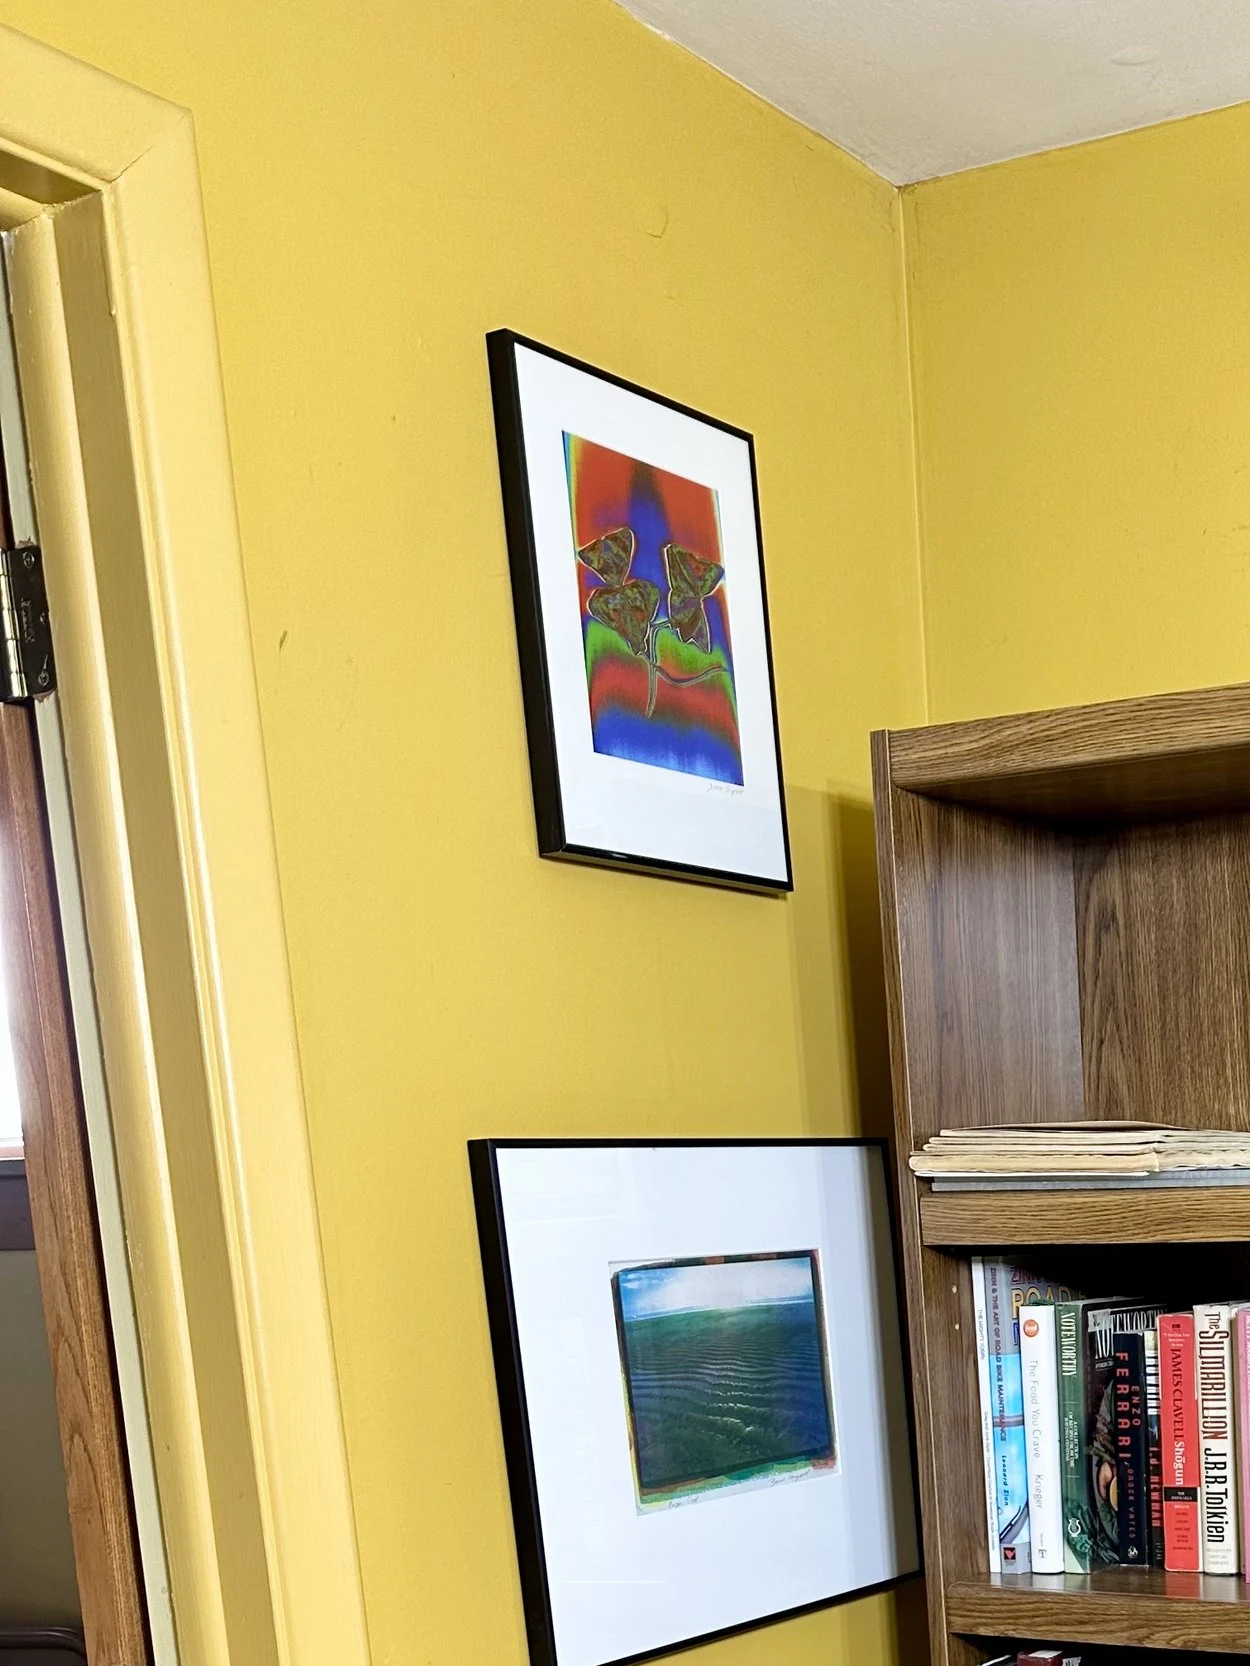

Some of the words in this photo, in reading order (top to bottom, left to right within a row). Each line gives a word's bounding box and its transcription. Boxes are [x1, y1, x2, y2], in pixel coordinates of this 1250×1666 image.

[1205, 1312, 1221, 1330] The
[1060, 1312, 1077, 1377] NOTEWORTHY
[1029, 1360, 1038, 1378] The
[1171, 1350, 1182, 1387] JAMES
[1198, 1330, 1228, 1440] SILMARILLION
[1030, 1381, 1040, 1404] Food
[1115, 1353, 1132, 1459] FERRARI
[1131, 1386, 1141, 1426] ENZO
[1031, 1408, 1040, 1425] You
[1172, 1388, 1184, 1442] CLAVELL
[1032, 1429, 1042, 1458] Crave
[1174, 1441, 1186, 1486] Shōgun
[1204, 1448, 1227, 1488] J.R.R.
[1033, 1474, 1044, 1508] Krieger
[1205, 1488, 1228, 1543] Tolkien
